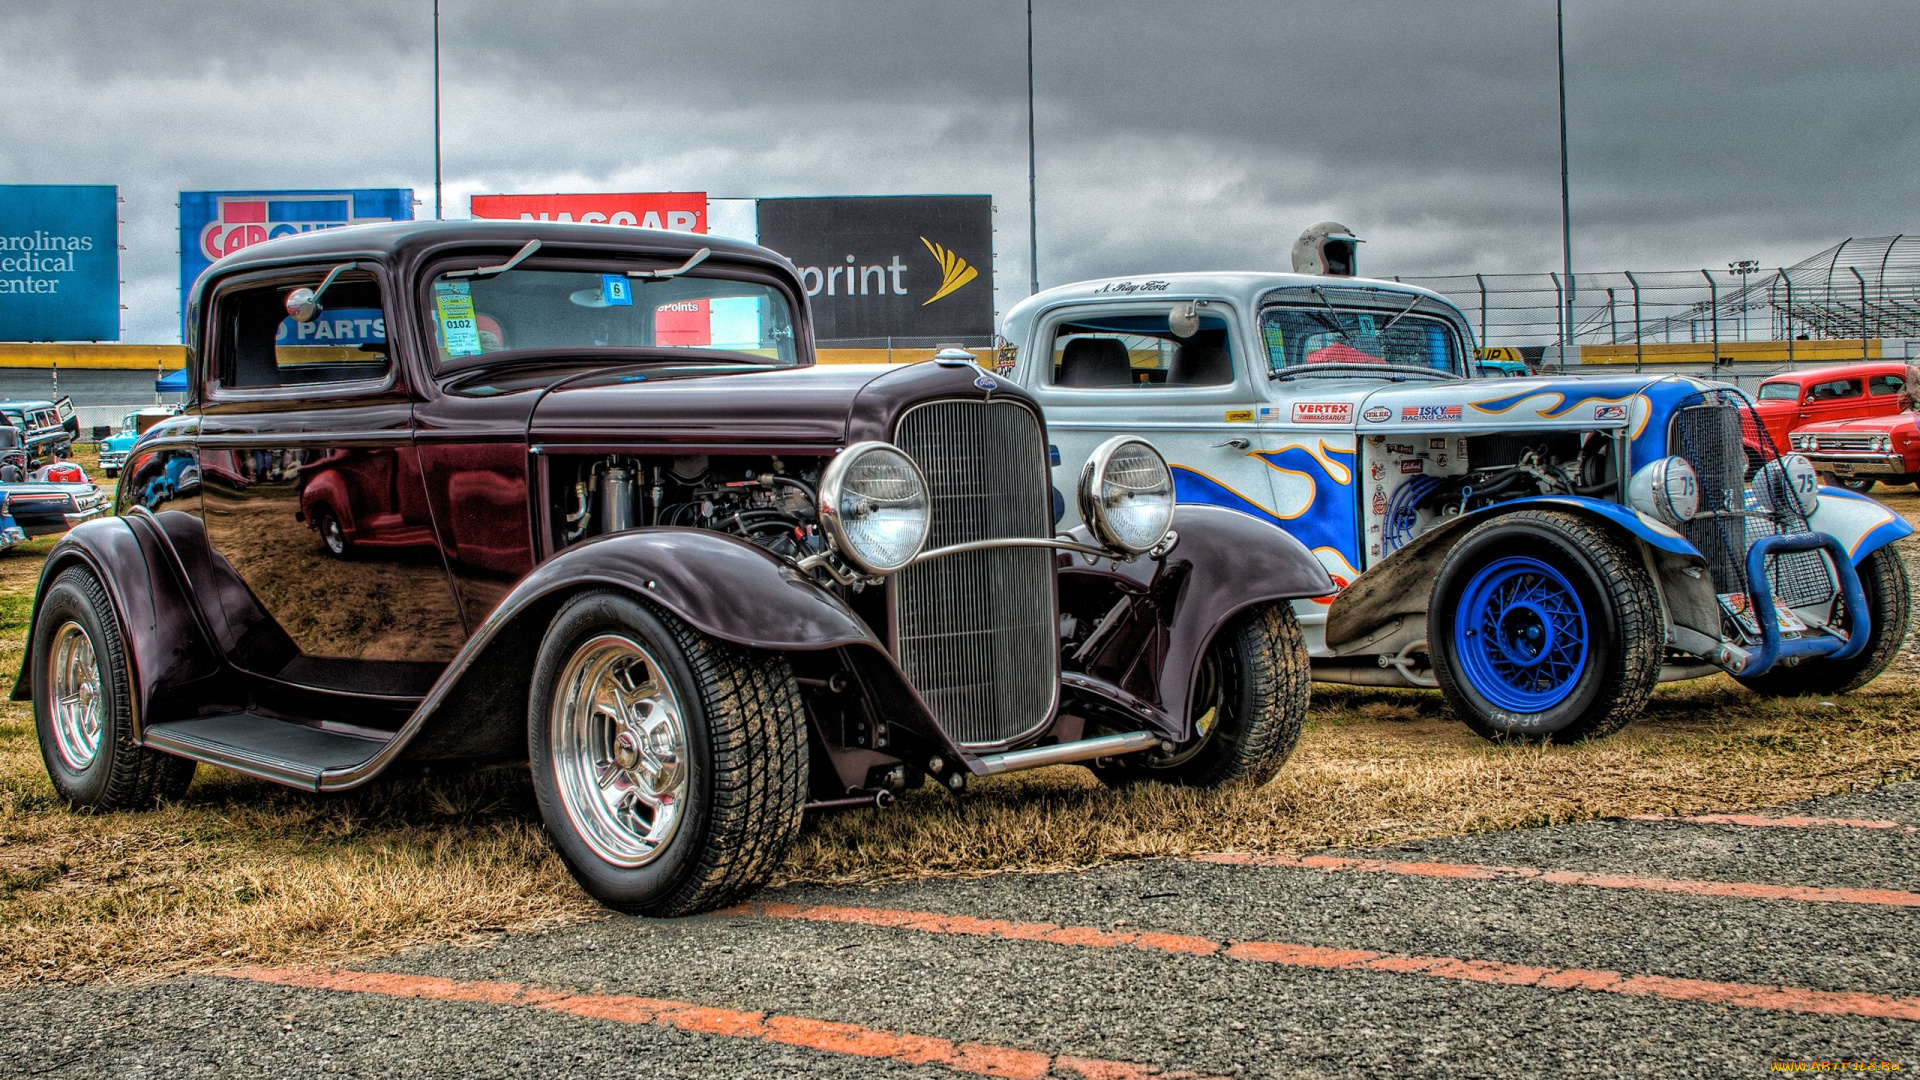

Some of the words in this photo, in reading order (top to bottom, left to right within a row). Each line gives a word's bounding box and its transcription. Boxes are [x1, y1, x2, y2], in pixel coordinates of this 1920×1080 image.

[0, 251, 75, 272] edical
[788, 254, 908, 297] print
[613, 283, 621, 294] 6
[1140, 280, 1171, 291] Ford
[298, 319, 386, 340] PARTS
[446, 319, 471, 329] 0102
[1298, 404, 1348, 414] VERTEX
[1418, 406, 1447, 416] ISKY
[1679, 475, 1695, 497] 75
[1796, 473, 1813, 494] 75
